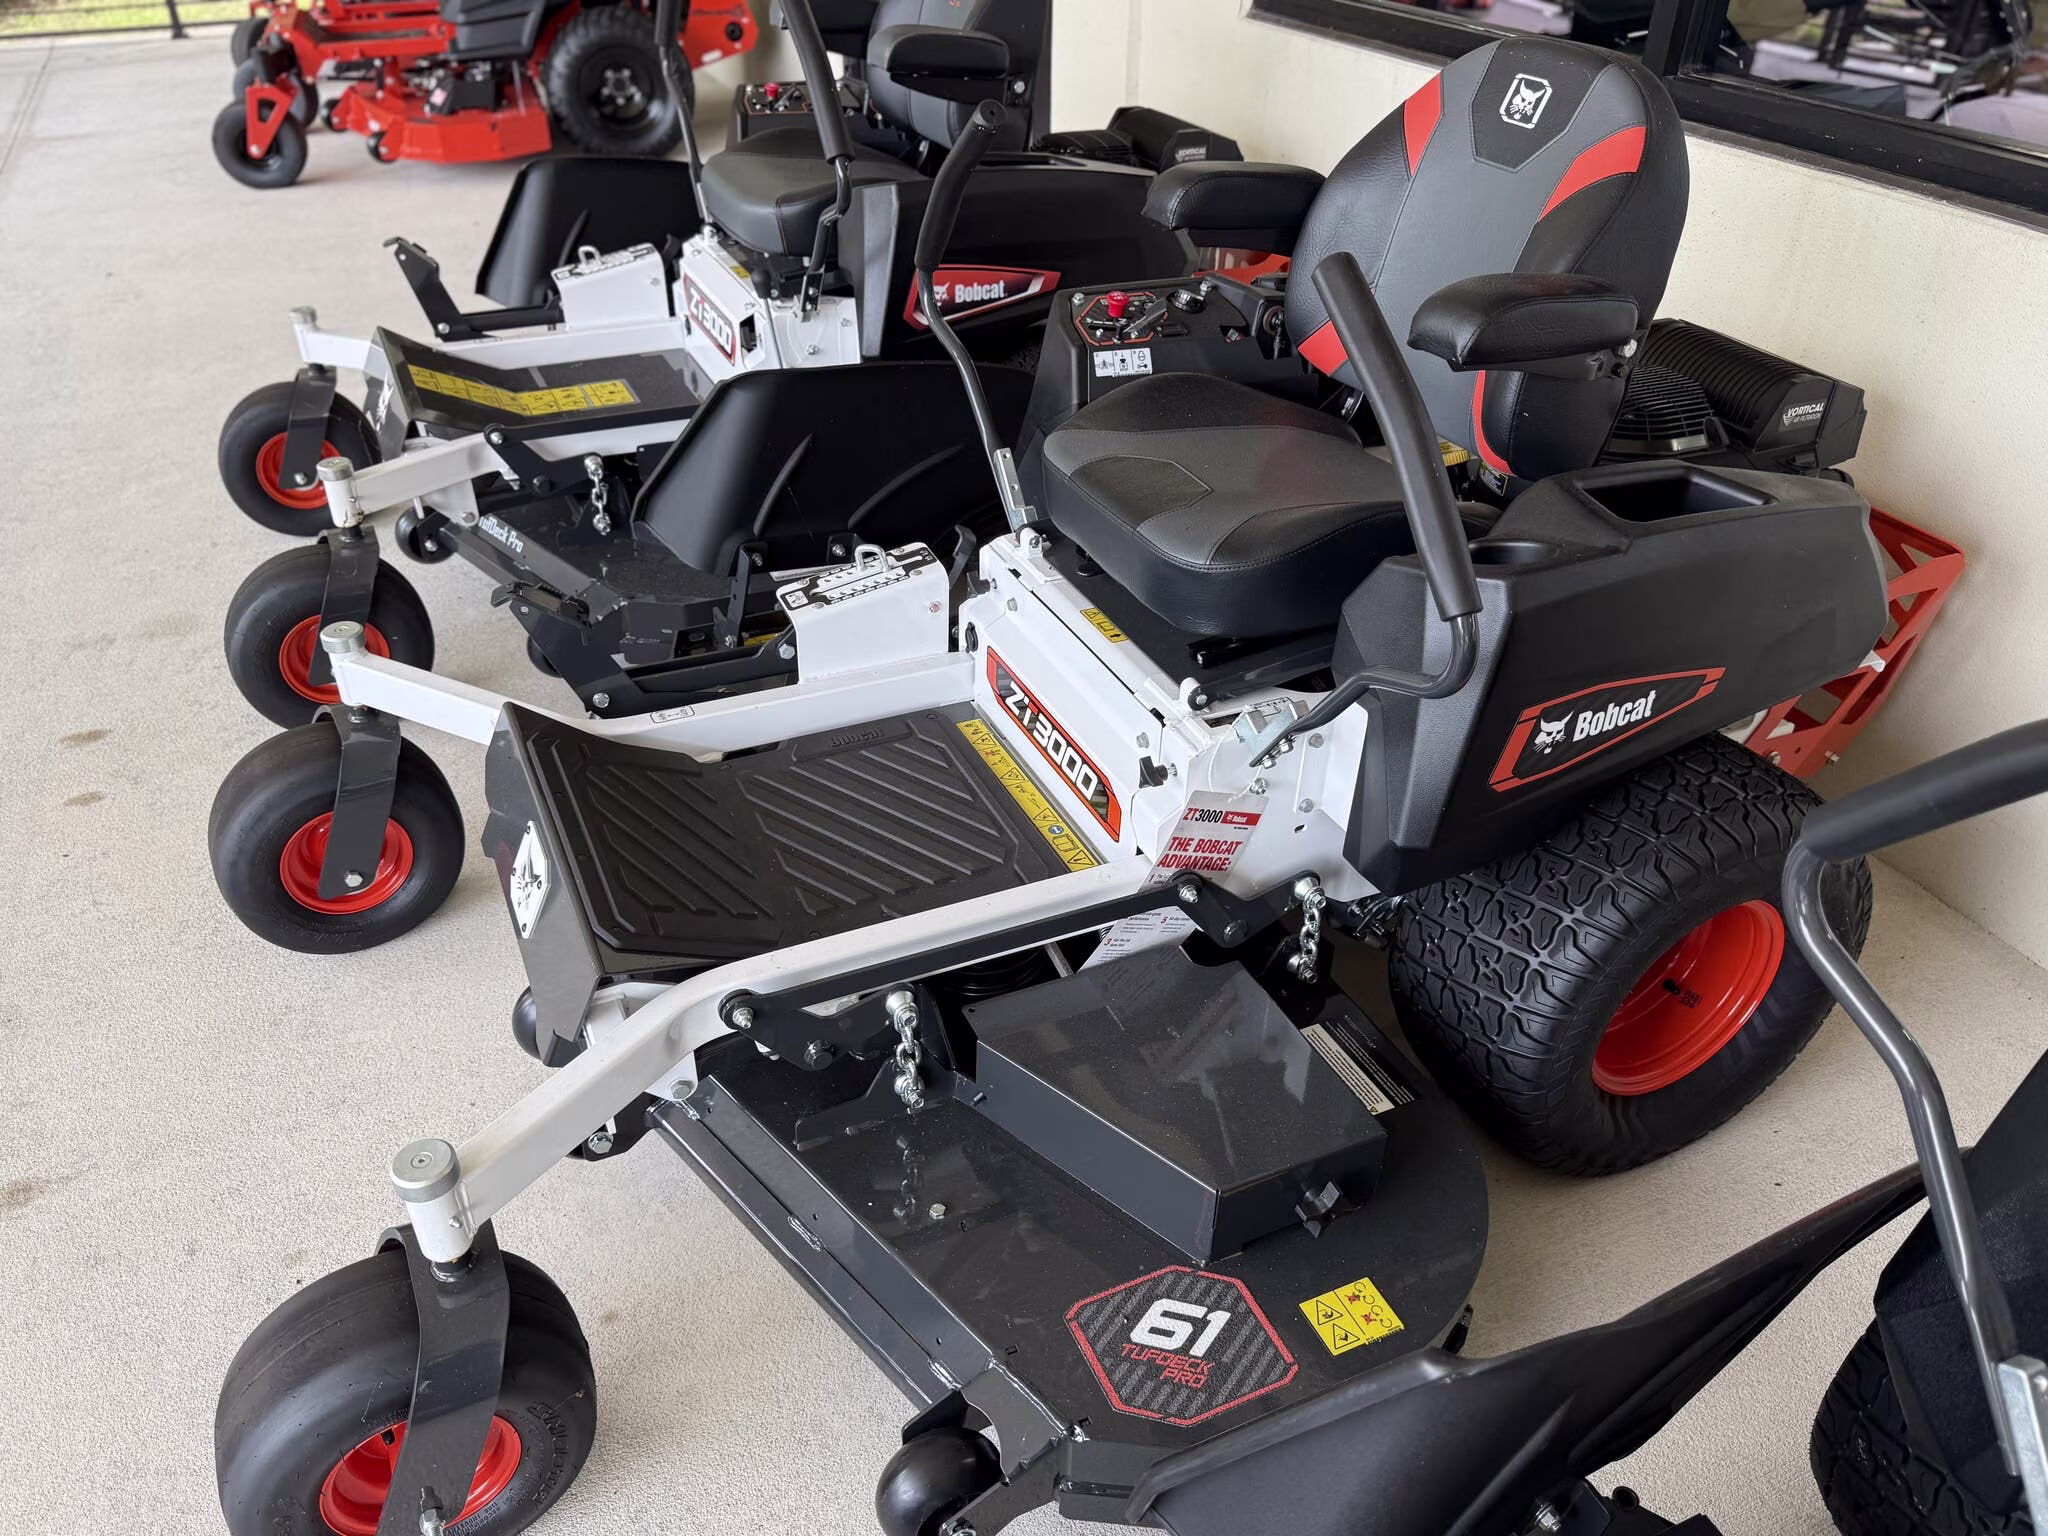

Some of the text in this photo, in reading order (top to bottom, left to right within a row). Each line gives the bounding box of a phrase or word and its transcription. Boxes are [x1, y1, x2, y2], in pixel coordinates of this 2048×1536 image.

[954, 279, 1006, 304] Bobcat
[1787, 403, 1825, 418] VORTICAL
[507, 530, 524, 553] Pro
[1572, 689, 1657, 742] Bobcat
[1005, 680, 1099, 801] ZT3000
[1183, 807, 1223, 823] ZT3000
[1167, 836, 1244, 856] THE BOBCAT
[1156, 853, 1232, 872] ADVANTAGE:
[1130, 1298, 1232, 1358] 61
[1121, 1343, 1216, 1375] TUFDECK
[1159, 1367, 1207, 1389] PRO
